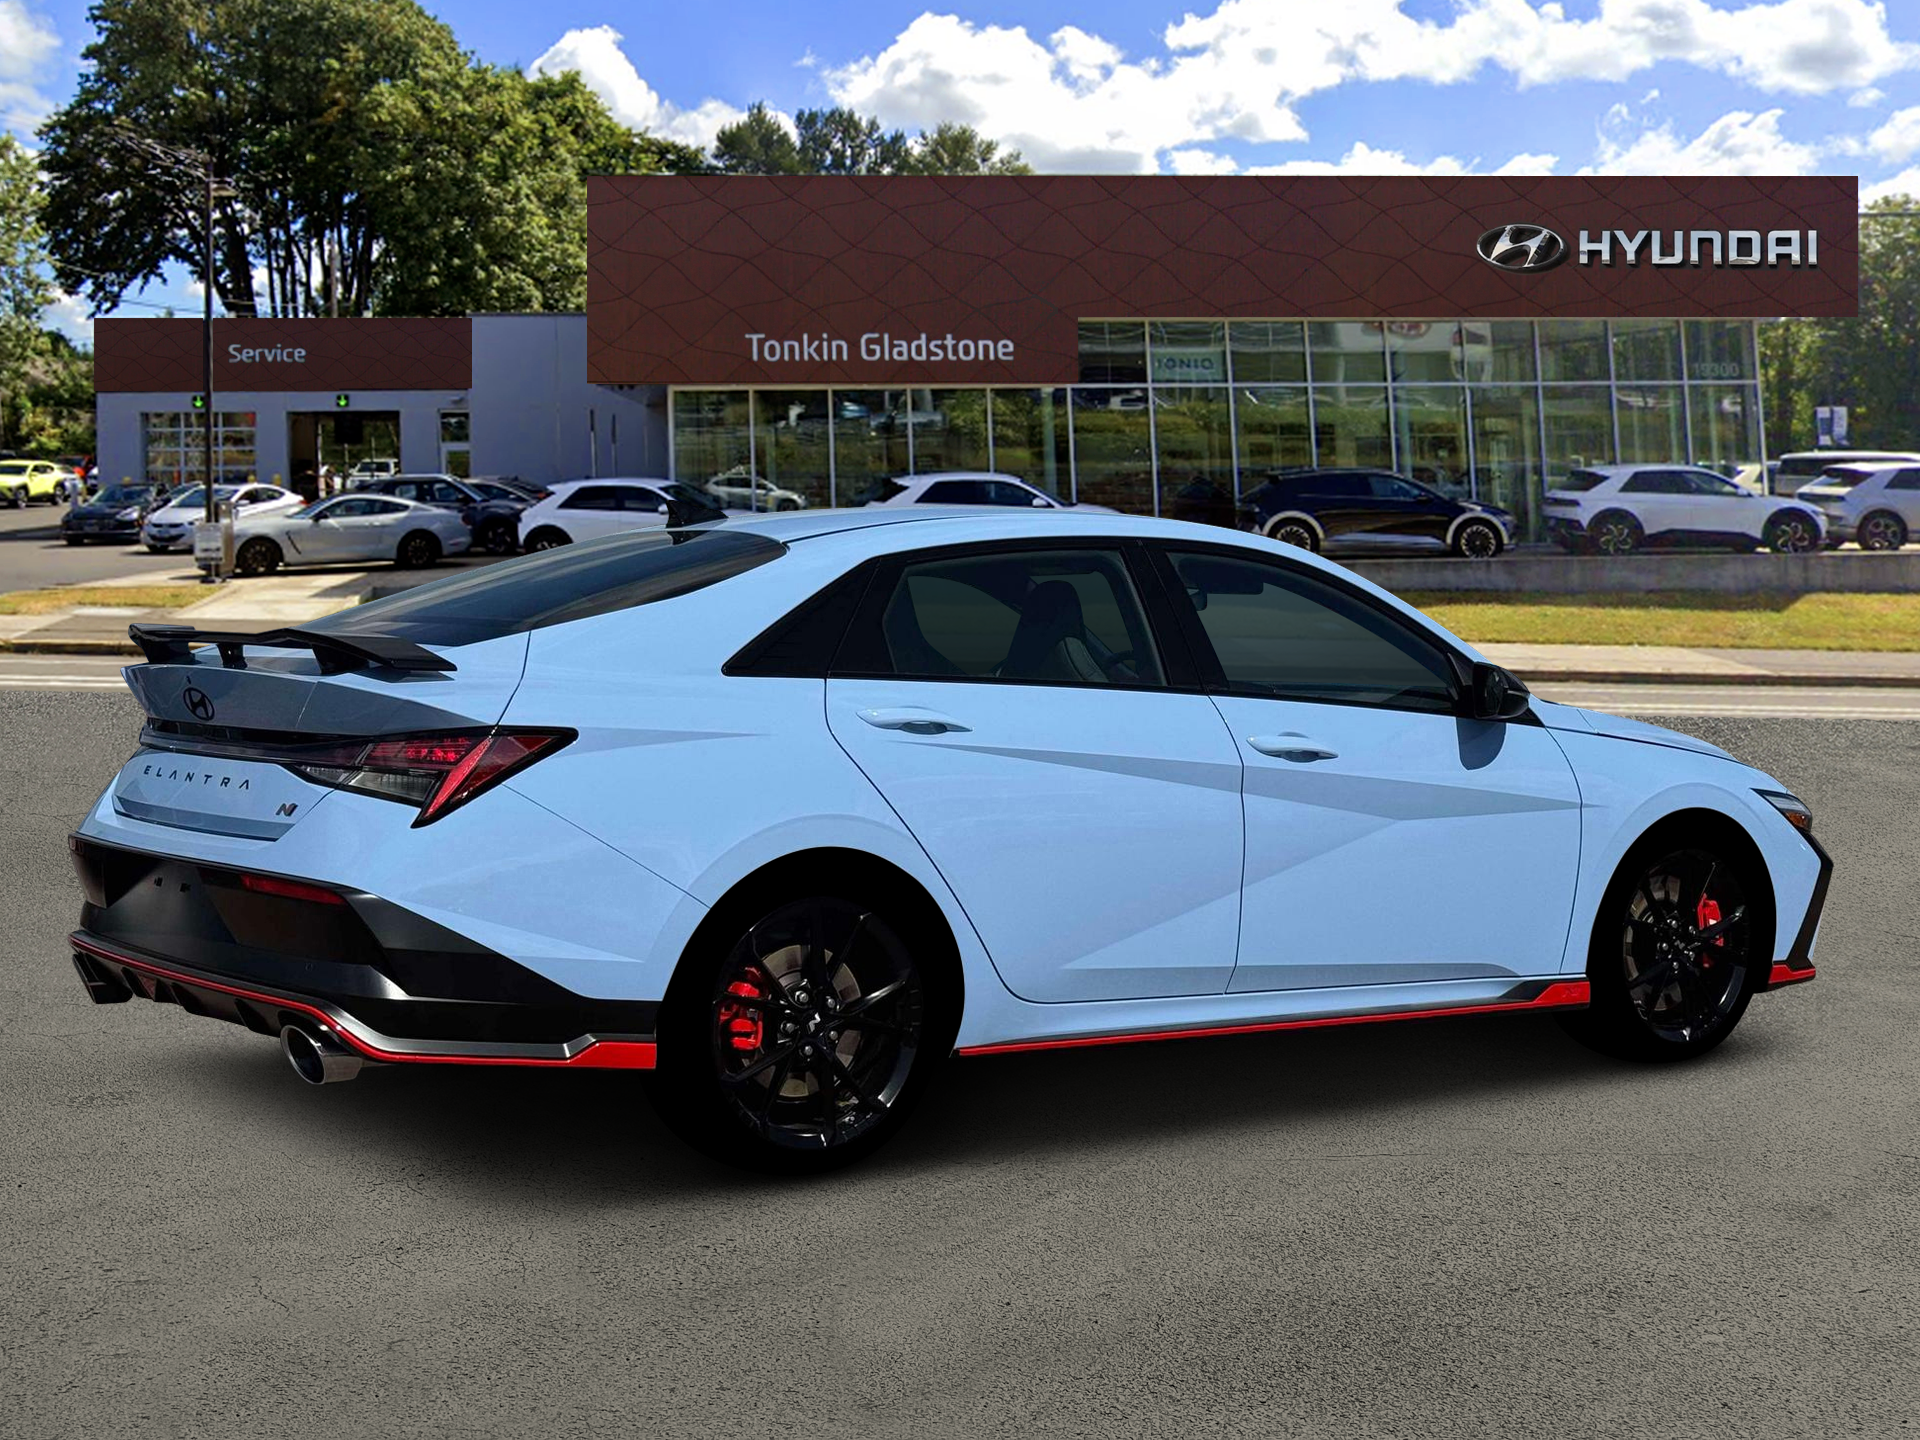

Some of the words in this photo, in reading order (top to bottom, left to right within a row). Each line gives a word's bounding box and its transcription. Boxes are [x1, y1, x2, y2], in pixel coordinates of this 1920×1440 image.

[1579, 230, 1818, 265] HYUNDAI
[227, 343, 307, 363] Service
[745, 333, 848, 362] Tonkin
[860, 333, 1015, 362] Gladstone
[143, 765, 251, 790] ELANTRA
